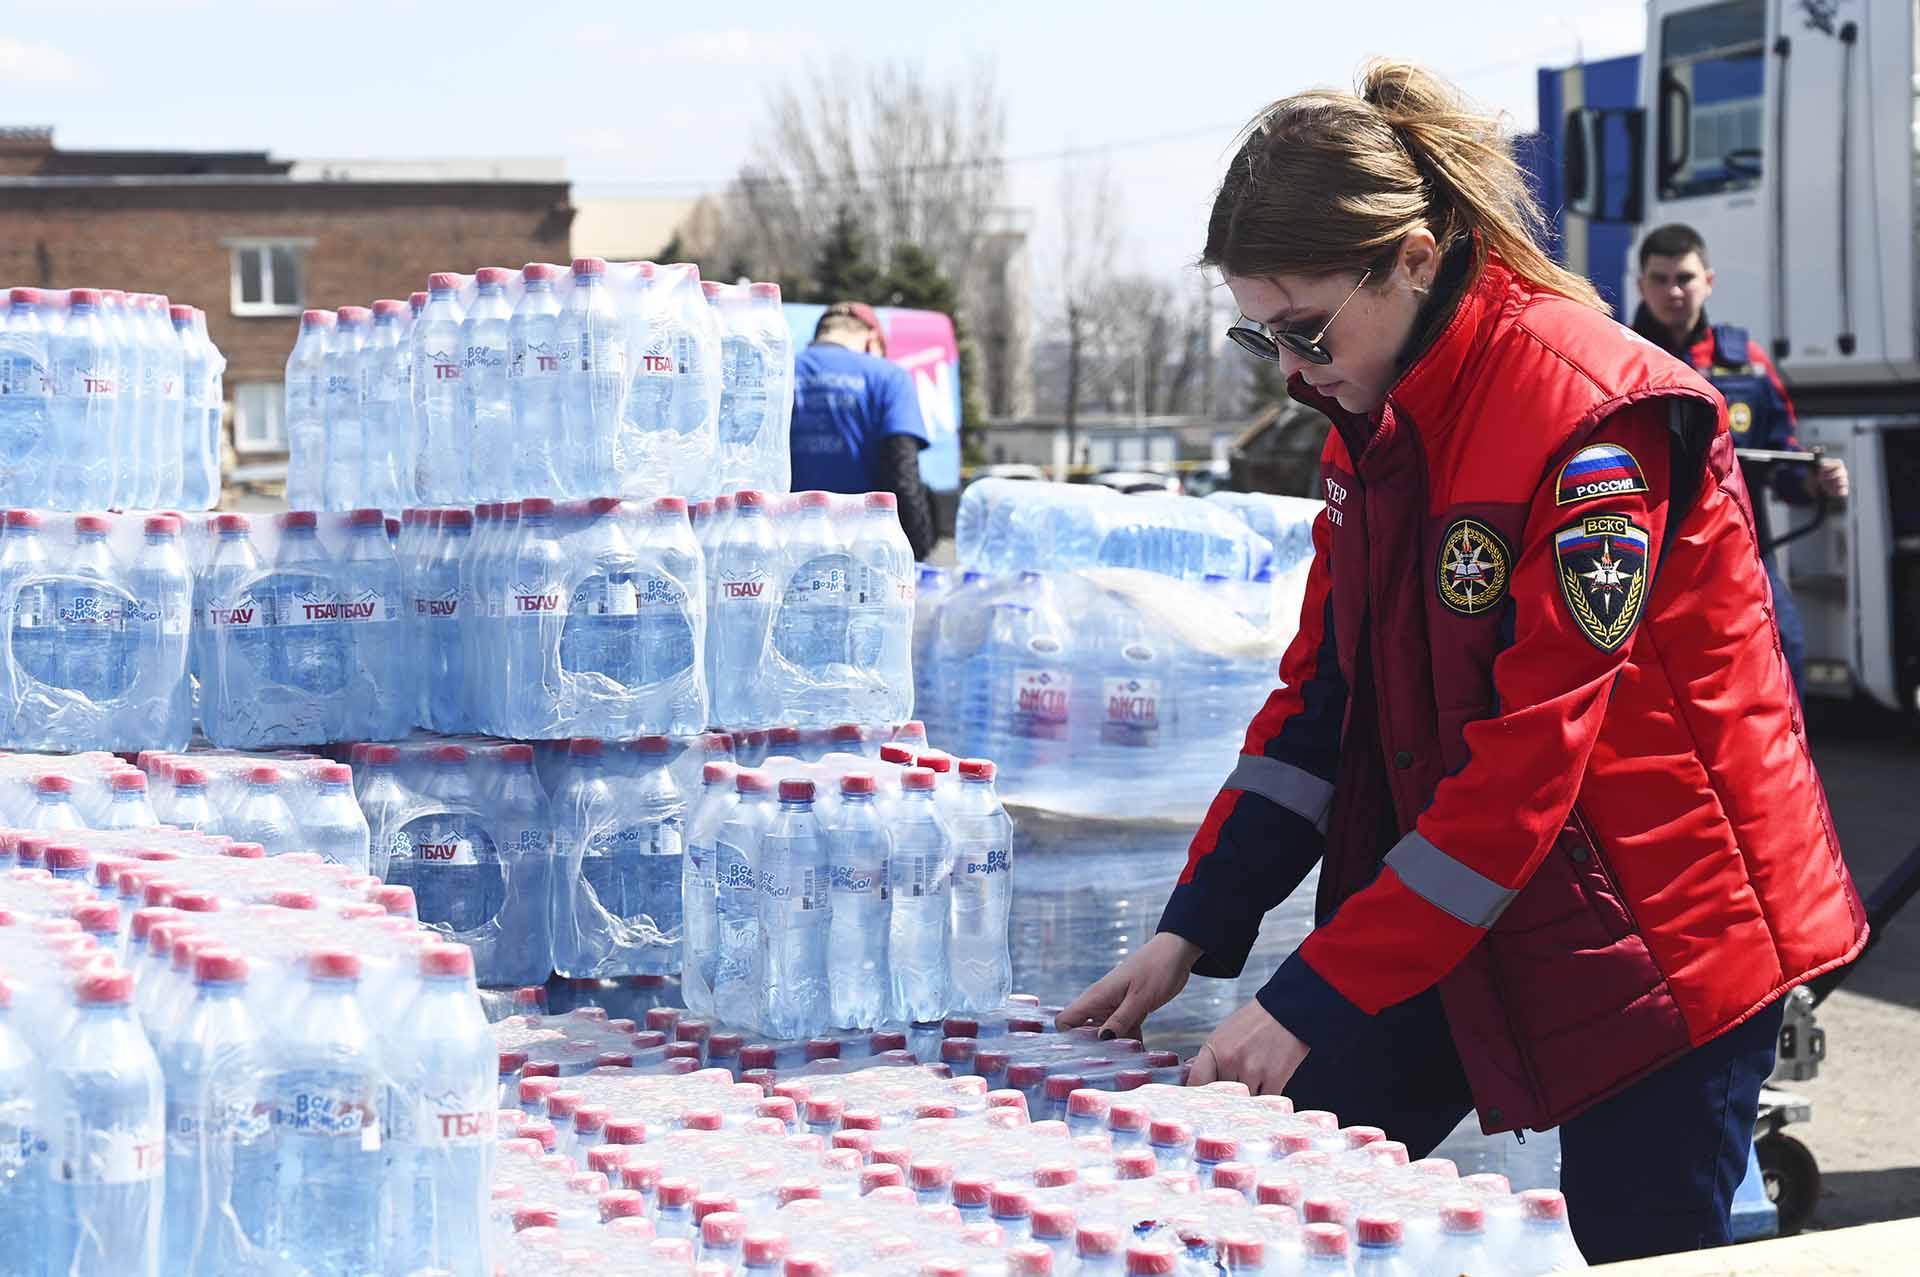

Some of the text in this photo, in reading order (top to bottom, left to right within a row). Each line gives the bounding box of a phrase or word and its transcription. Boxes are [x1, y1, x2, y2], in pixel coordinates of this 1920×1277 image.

[1576, 479, 1634, 497] РОССИЯ
[1587, 520, 1624, 532] ВСКС
[723, 582, 764, 598] ТБАУ
[514, 595, 559, 611] ТБАУ
[210, 608, 254, 624] ТБАУ
[418, 844, 457, 860] ТБАУ
